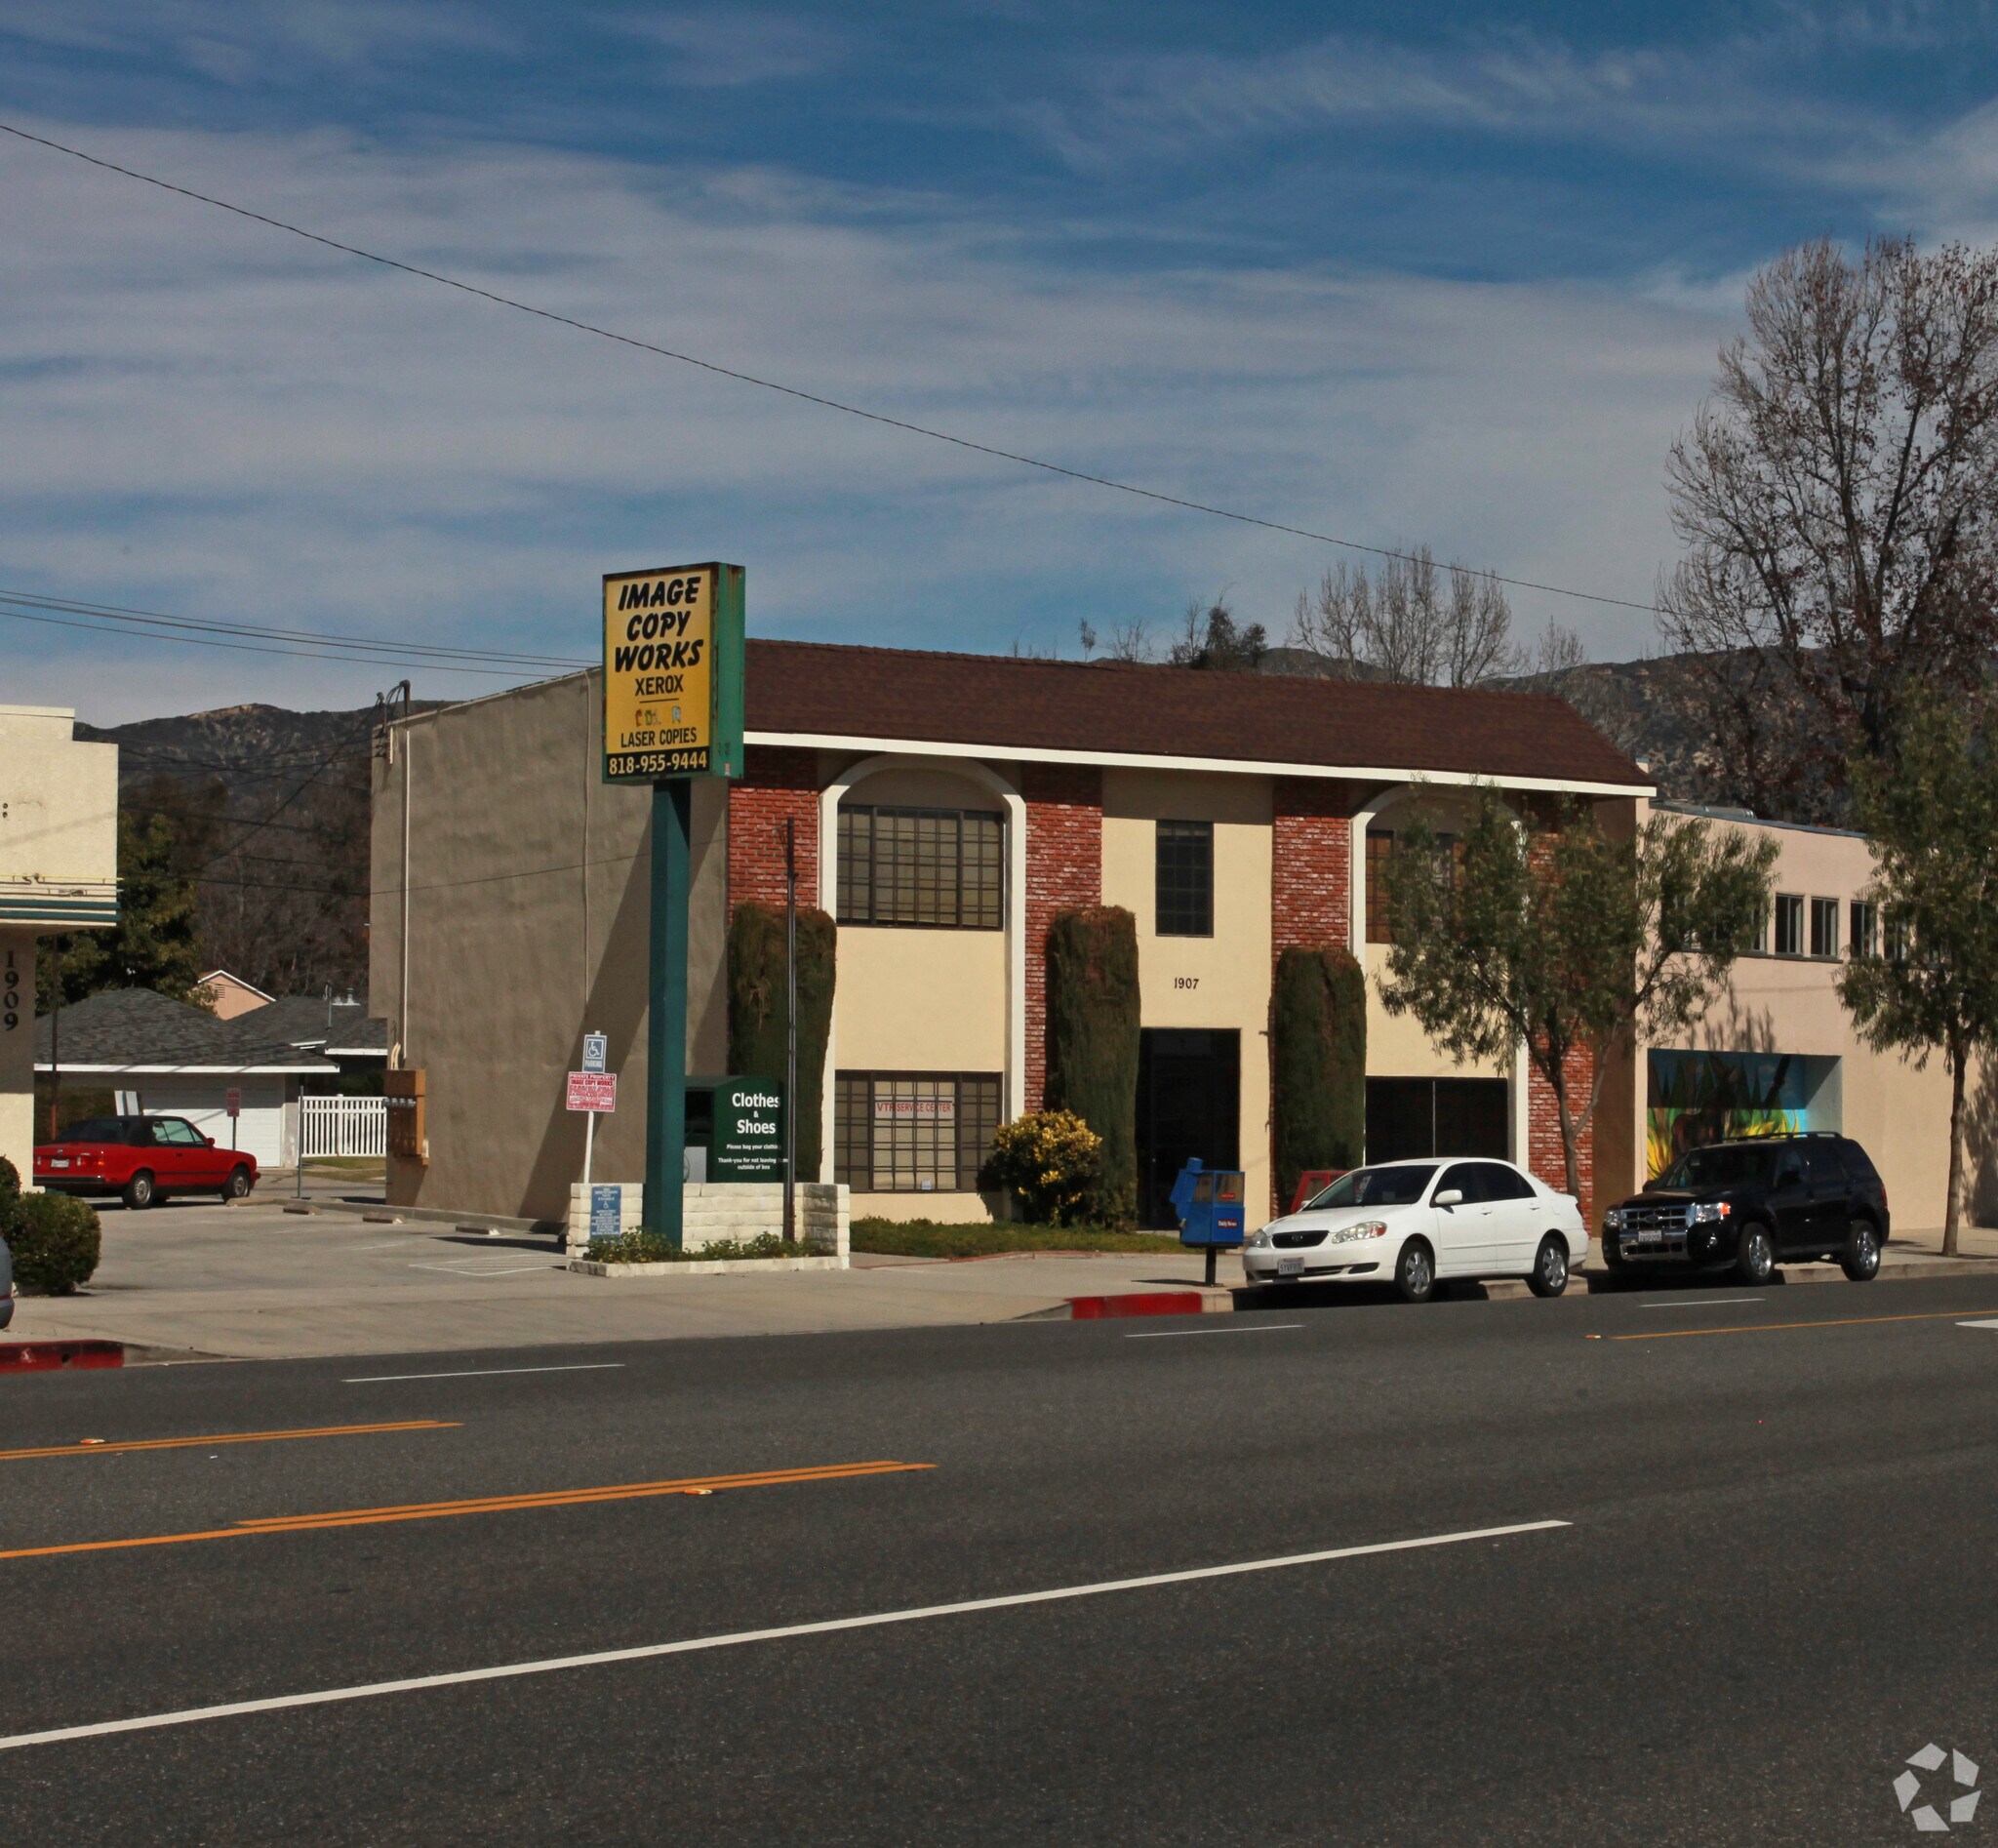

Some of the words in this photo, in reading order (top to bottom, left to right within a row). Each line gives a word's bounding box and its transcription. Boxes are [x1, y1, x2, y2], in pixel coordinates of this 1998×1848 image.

[618, 576, 701, 611] IMAGE
[626, 610, 692, 642] COPY
[615, 639, 704, 673] WORKS
[634, 674, 684, 697] XEROX
[620, 730, 656, 748] LASER
[659, 727, 698, 745] COPIES
[609, 750, 707, 776] 818-955-9444
[3, 950, 20, 1032] 1909
[1174, 977, 1200, 989] 1907
[732, 1093, 779, 1107] Clothes
[897, 1103, 924, 1112] SERVCE
[737, 1119, 776, 1134] Shoes
